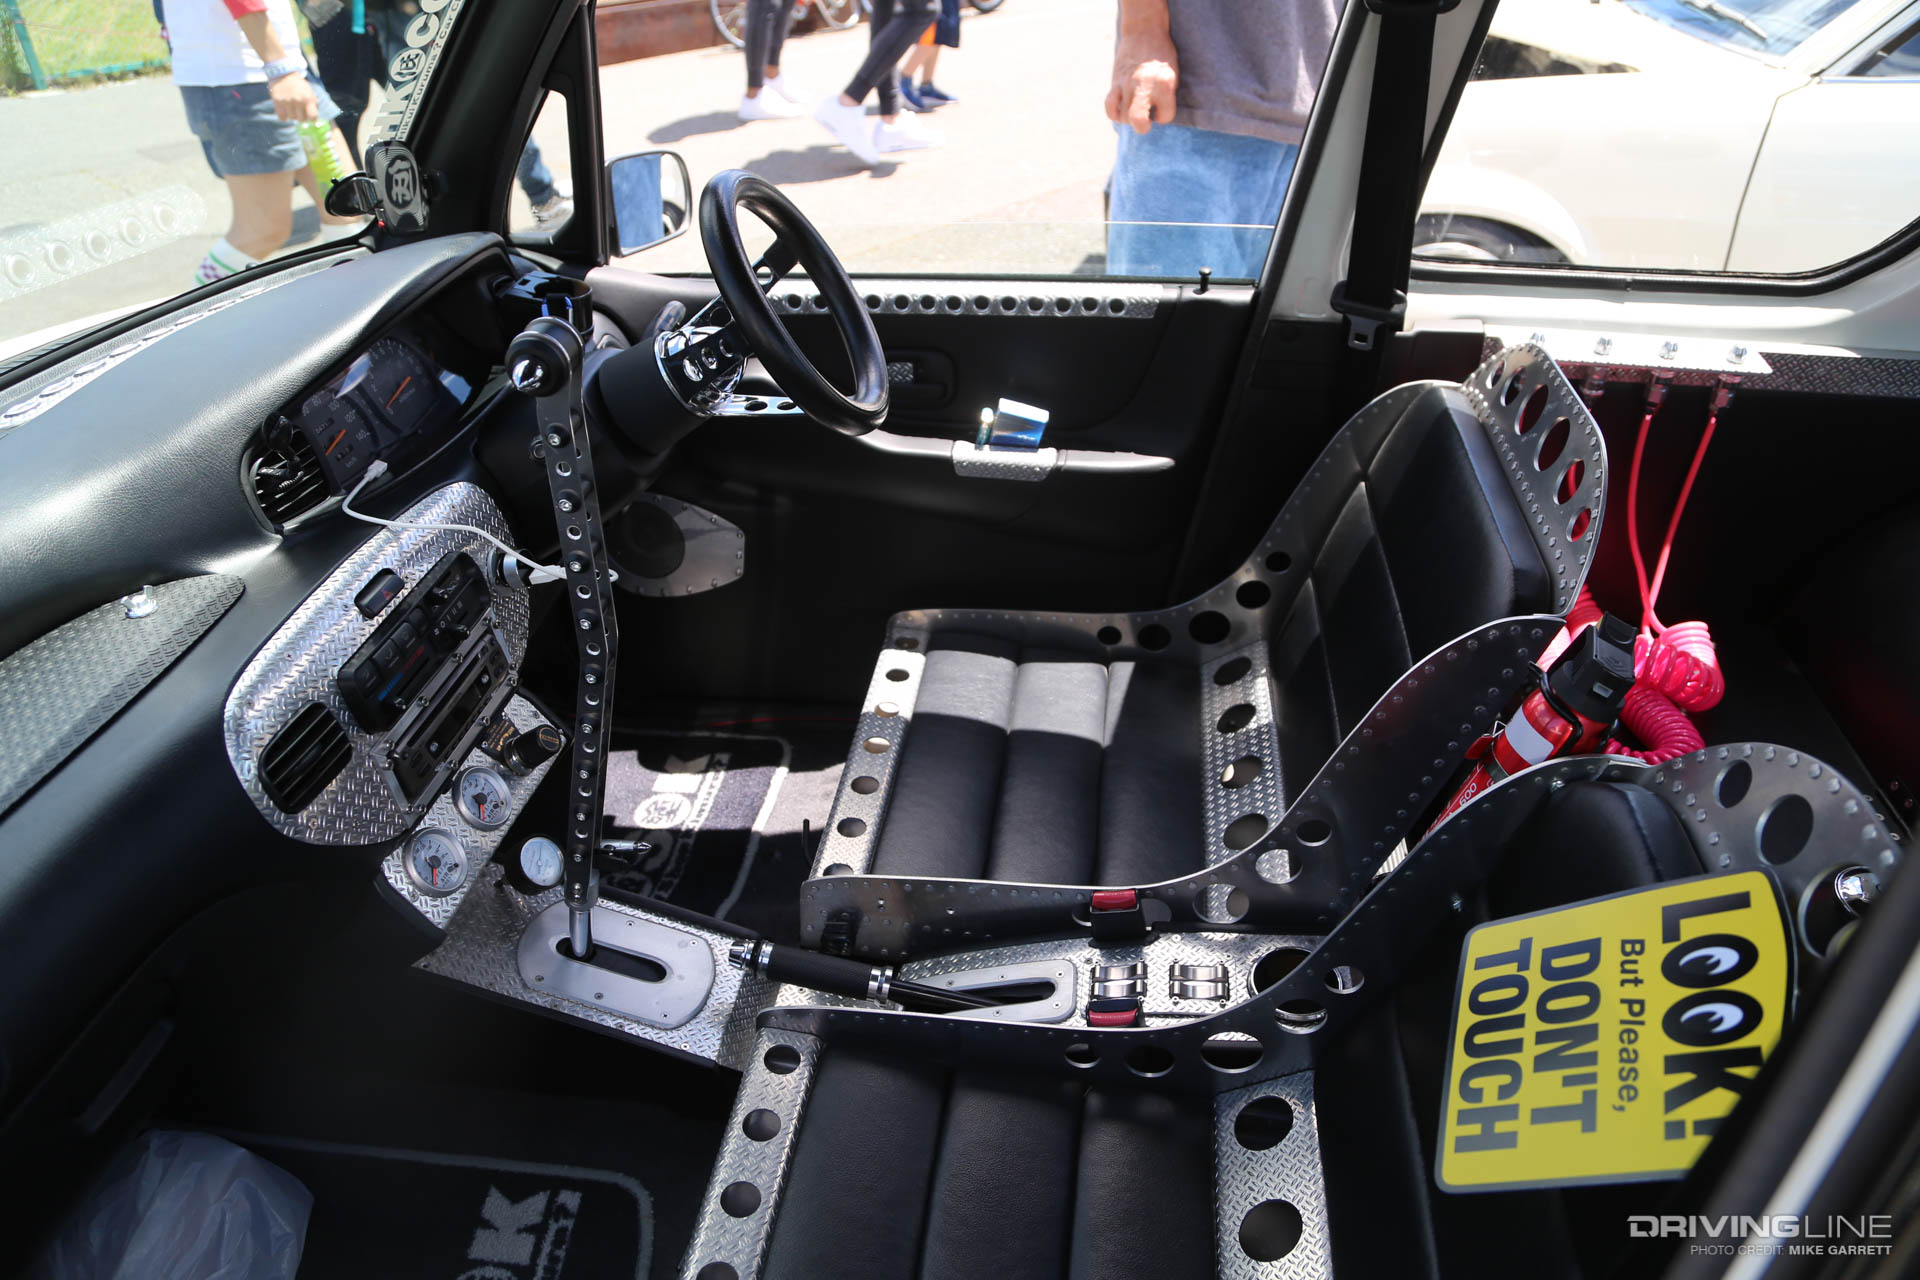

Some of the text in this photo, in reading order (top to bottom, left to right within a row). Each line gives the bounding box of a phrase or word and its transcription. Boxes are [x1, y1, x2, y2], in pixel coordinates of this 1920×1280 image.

[1454, 936, 1534, 1154] TOUCH
[1529, 936, 1602, 1134] DON'T
[1611, 937, 1646, 1113] But Please,
